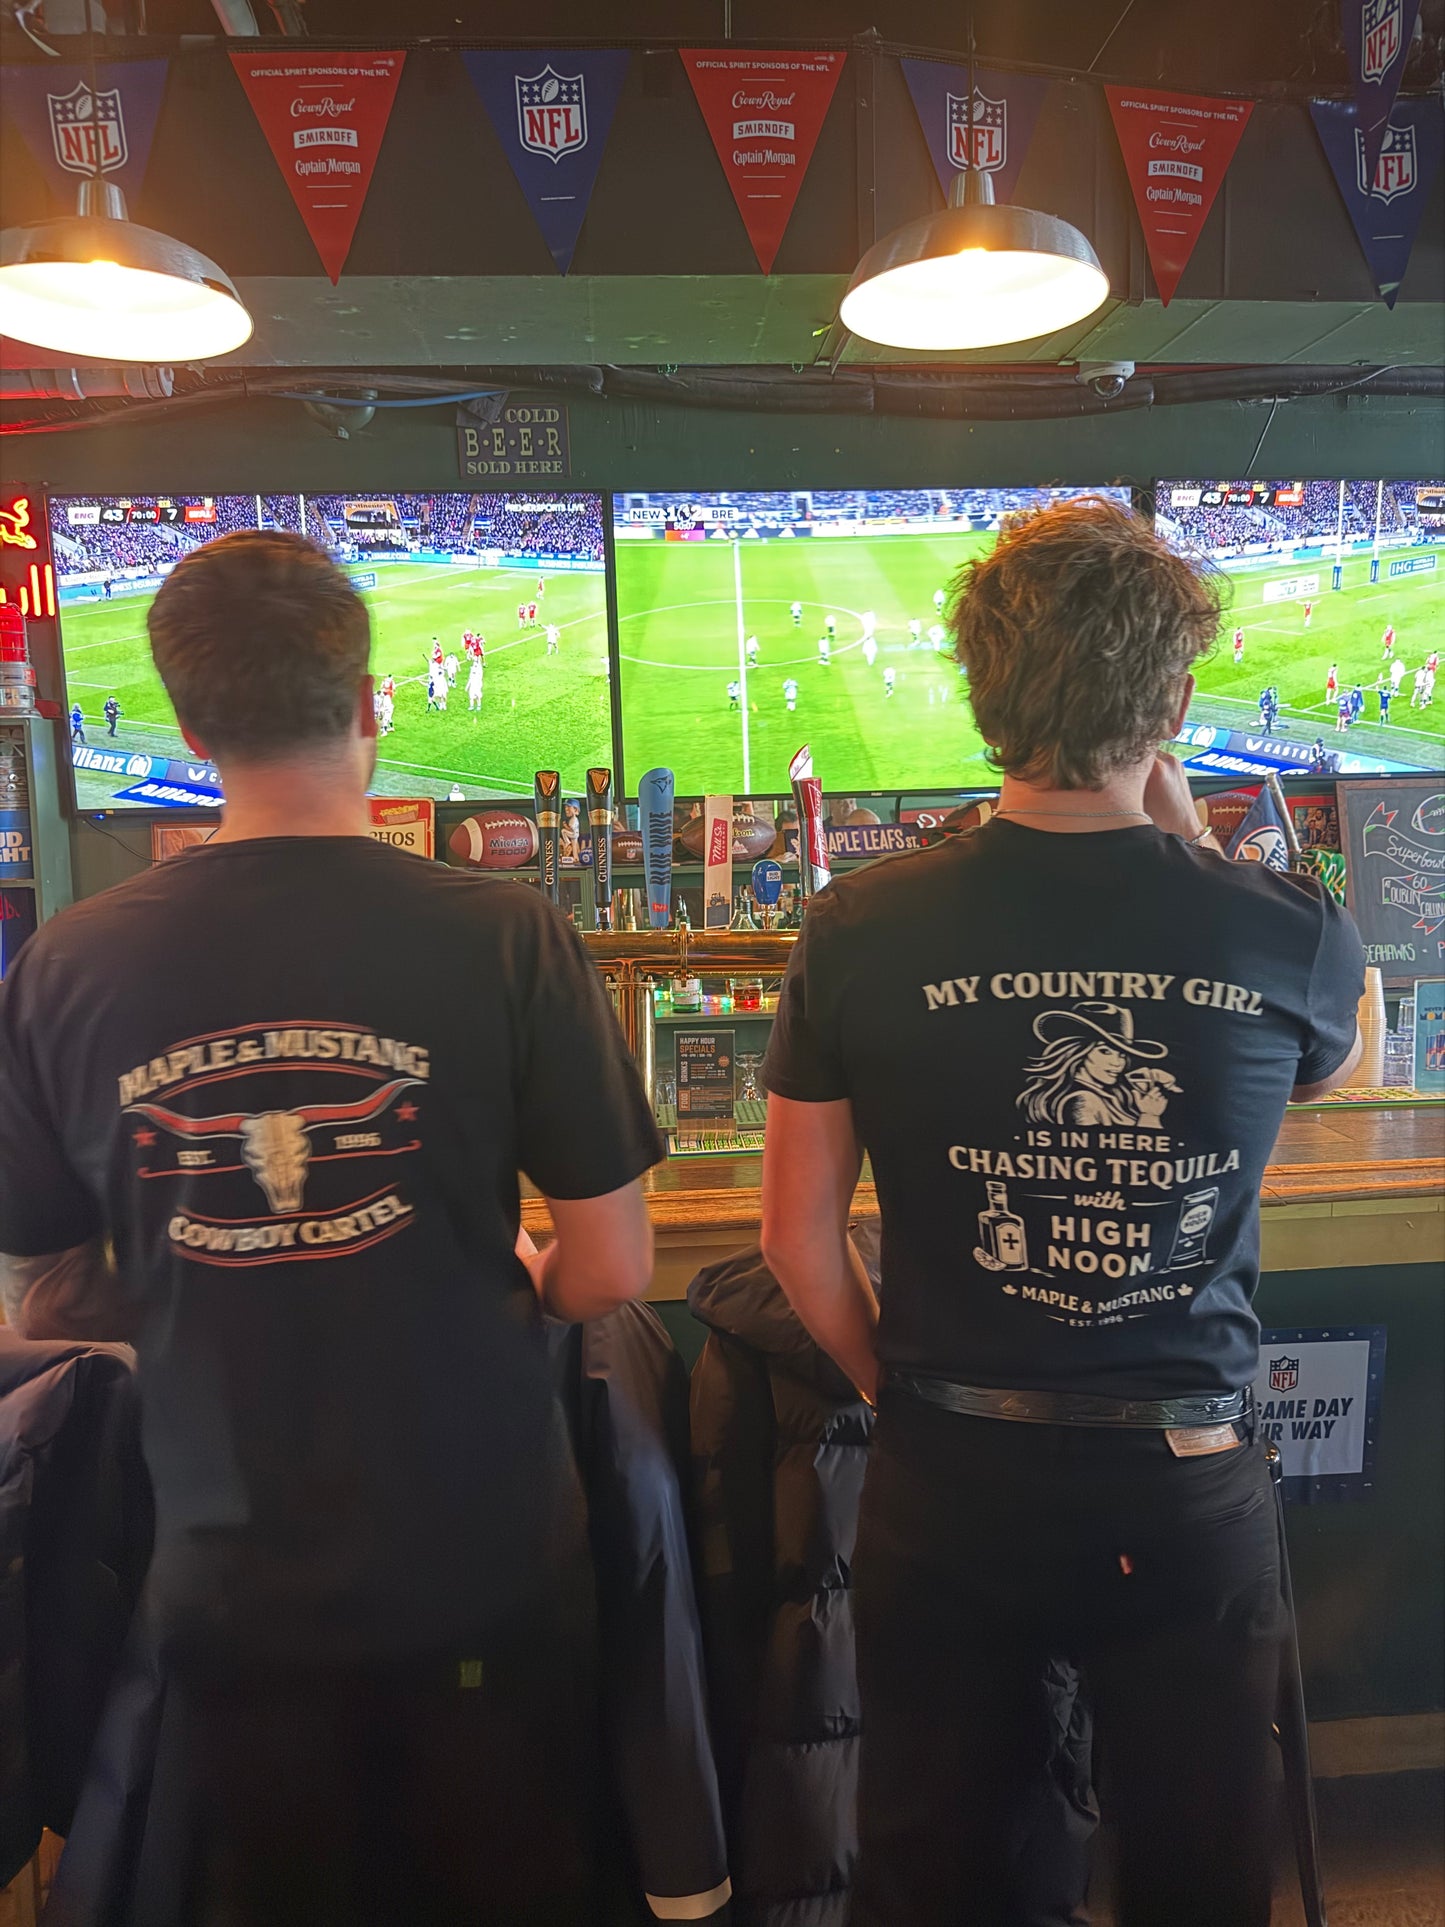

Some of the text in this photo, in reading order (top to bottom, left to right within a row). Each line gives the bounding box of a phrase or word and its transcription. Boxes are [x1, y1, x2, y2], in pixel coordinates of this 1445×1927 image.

[1366, 17, 1398, 73] NFL
[251, 67, 390, 77] OFFICIAL SPIRIT SPONSORS OF THE NFL
[696, 61, 830, 72] OFFICIAL SPIRIT SPONSORS OF THE NFL
[290, 97, 356, 118] Crown Royal
[732, 90, 796, 111] Crown Royal
[1120, 100, 1239, 121] OFFICIAL SPIRIT SPONSORS OF THE NFL
[299, 130, 352, 145] SMIRNOFF
[526, 107, 580, 149] NFL
[738, 123, 790, 136] SMIRNOFF
[60, 125, 119, 166] NFL
[954, 126, 1000, 166] NFL
[1149, 132, 1206, 154] Crown Royal
[295, 158, 361, 176] Captain Morgan
[733, 149, 796, 167] Captain Morgan
[1152, 163, 1199, 178] SMIRNOFF
[1146, 186, 1202, 206] Captain Morgan
[505, 408, 560, 423] COLD
[467, 460, 563, 475] SOLD HERE
[1202, 491, 1222, 504] 43
[1259, 492, 1270, 504] 7
[74, 511, 95, 520] ENG
[102, 508, 124, 522] 43
[131, 510, 157, 520] 70:00
[167, 508, 178, 521] 7
[632, 510, 661, 520] NEW
[711, 508, 735, 519] BRE
[1391, 560, 1412, 575] IHG
[72, 746, 127, 773] llianz
[128, 783, 227, 807] Allianz
[864, 829, 904, 850] LEAFS
[906, 837, 921, 849] ST.
[545, 840, 554, 885] GUINNESS
[597, 837, 607, 883] GUINNESS
[1412, 876, 1428, 890] 60
[1390, 887, 1420, 906] DUBLIN
[922, 971, 1265, 1016] MY COUNTRY GIRL
[680, 1037, 716, 1045] HAPPY HOUR
[680, 1045, 716, 1054] SPECIALS
[118, 1030, 431, 1107] MAPLE & MUSTANG
[680, 1060, 689, 1083] DRINKS
[681, 1092, 689, 1109] FOOD
[1027, 1130, 1171, 1152] IS IN HERE
[949, 1145, 1241, 1190] CHASING TEQUILA
[1074, 1190, 1127, 1211] with
[168, 1195, 414, 1252] COWBOY CARTEL
[1051, 1215, 1151, 1248] HIGH
[1022, 1284, 1175, 1315] MAPLE & MUSTANG
[1068, 1318, 1095, 1328] EST.
[1271, 1371, 1297, 1389] NFL
[1312, 1397, 1354, 1418] DAY
[1291, 1420, 1337, 1441] WAY
